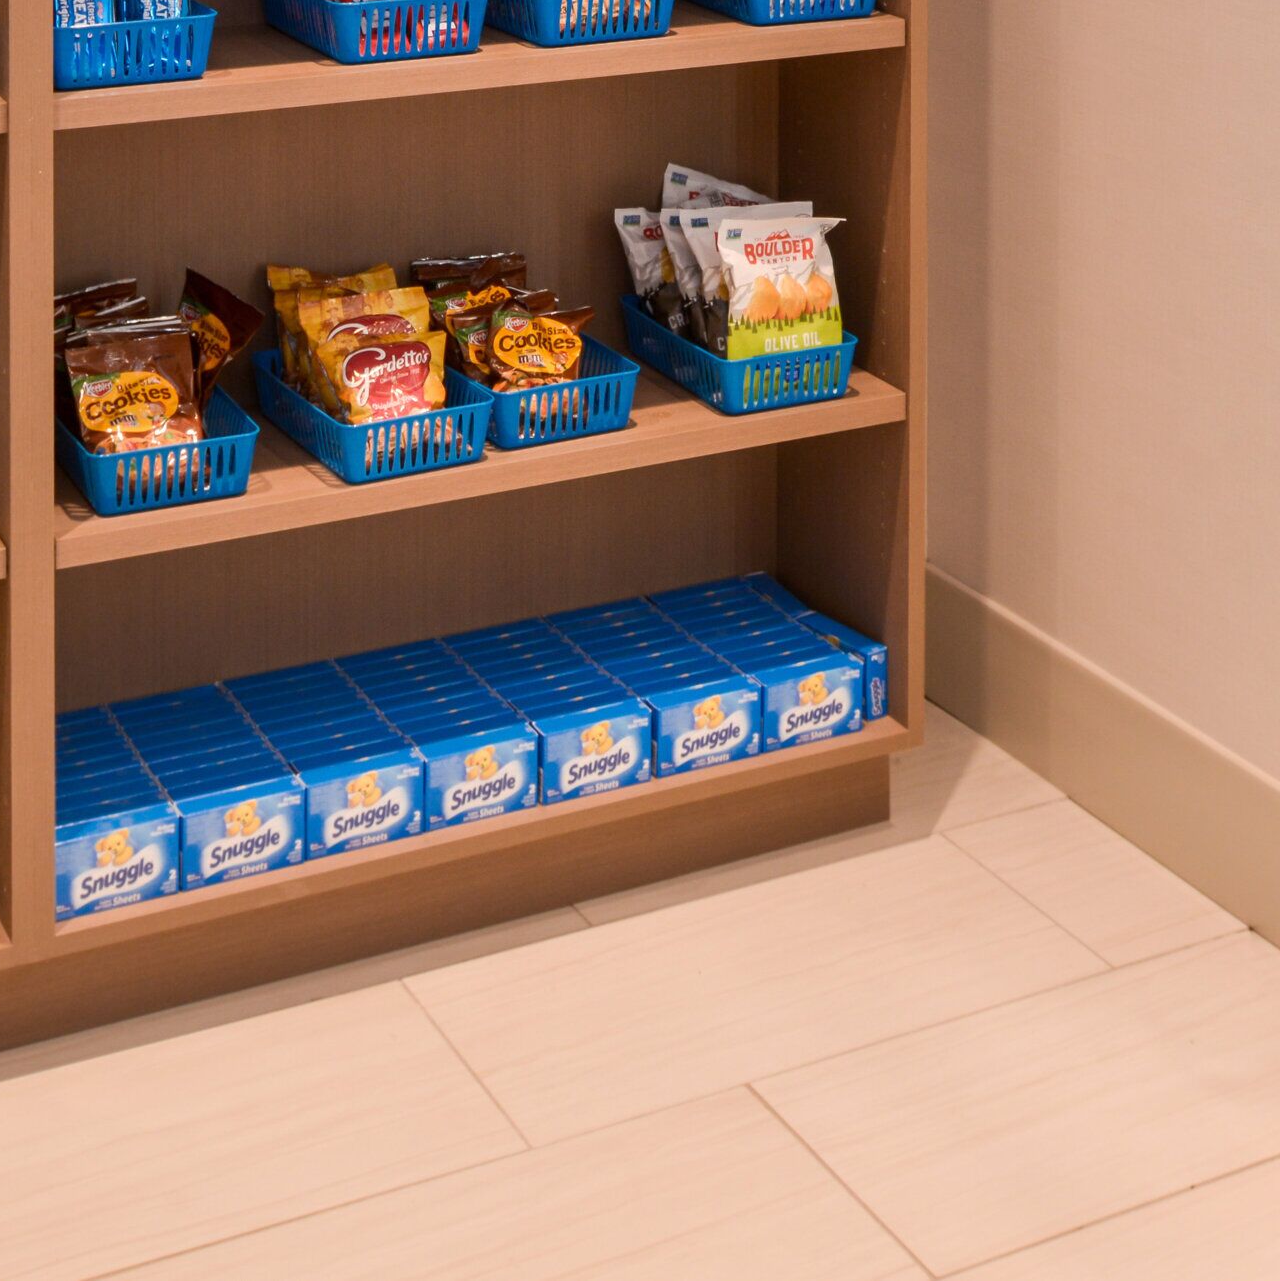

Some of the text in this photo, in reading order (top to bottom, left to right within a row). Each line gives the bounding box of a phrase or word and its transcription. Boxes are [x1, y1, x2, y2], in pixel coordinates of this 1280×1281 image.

[744, 237, 815, 265] BOULDER
[761, 255, 798, 265] CANYON
[498, 333, 577, 353] Cookies
[765, 331, 821, 353] OLIVE OIL
[85, 385, 172, 421] Cookies
[786, 699, 843, 734] Snuggle
[681, 722, 740, 758] Snuggle
[810, 728, 832, 741] Sheets
[568, 748, 630, 786] Snuggle
[706, 752, 730, 766] Sheets
[451, 773, 516, 812] Snuggle
[595, 778, 619, 793] Sheets
[332, 799, 400, 838] Snuggle
[479, 804, 504, 818] Sheets
[210, 829, 280, 869] Snuggle
[362, 831, 388, 845] Sheets
[241, 860, 268, 874] Sheets
[80, 858, 154, 899] Snuggle
[113, 891, 141, 905] Sheets
